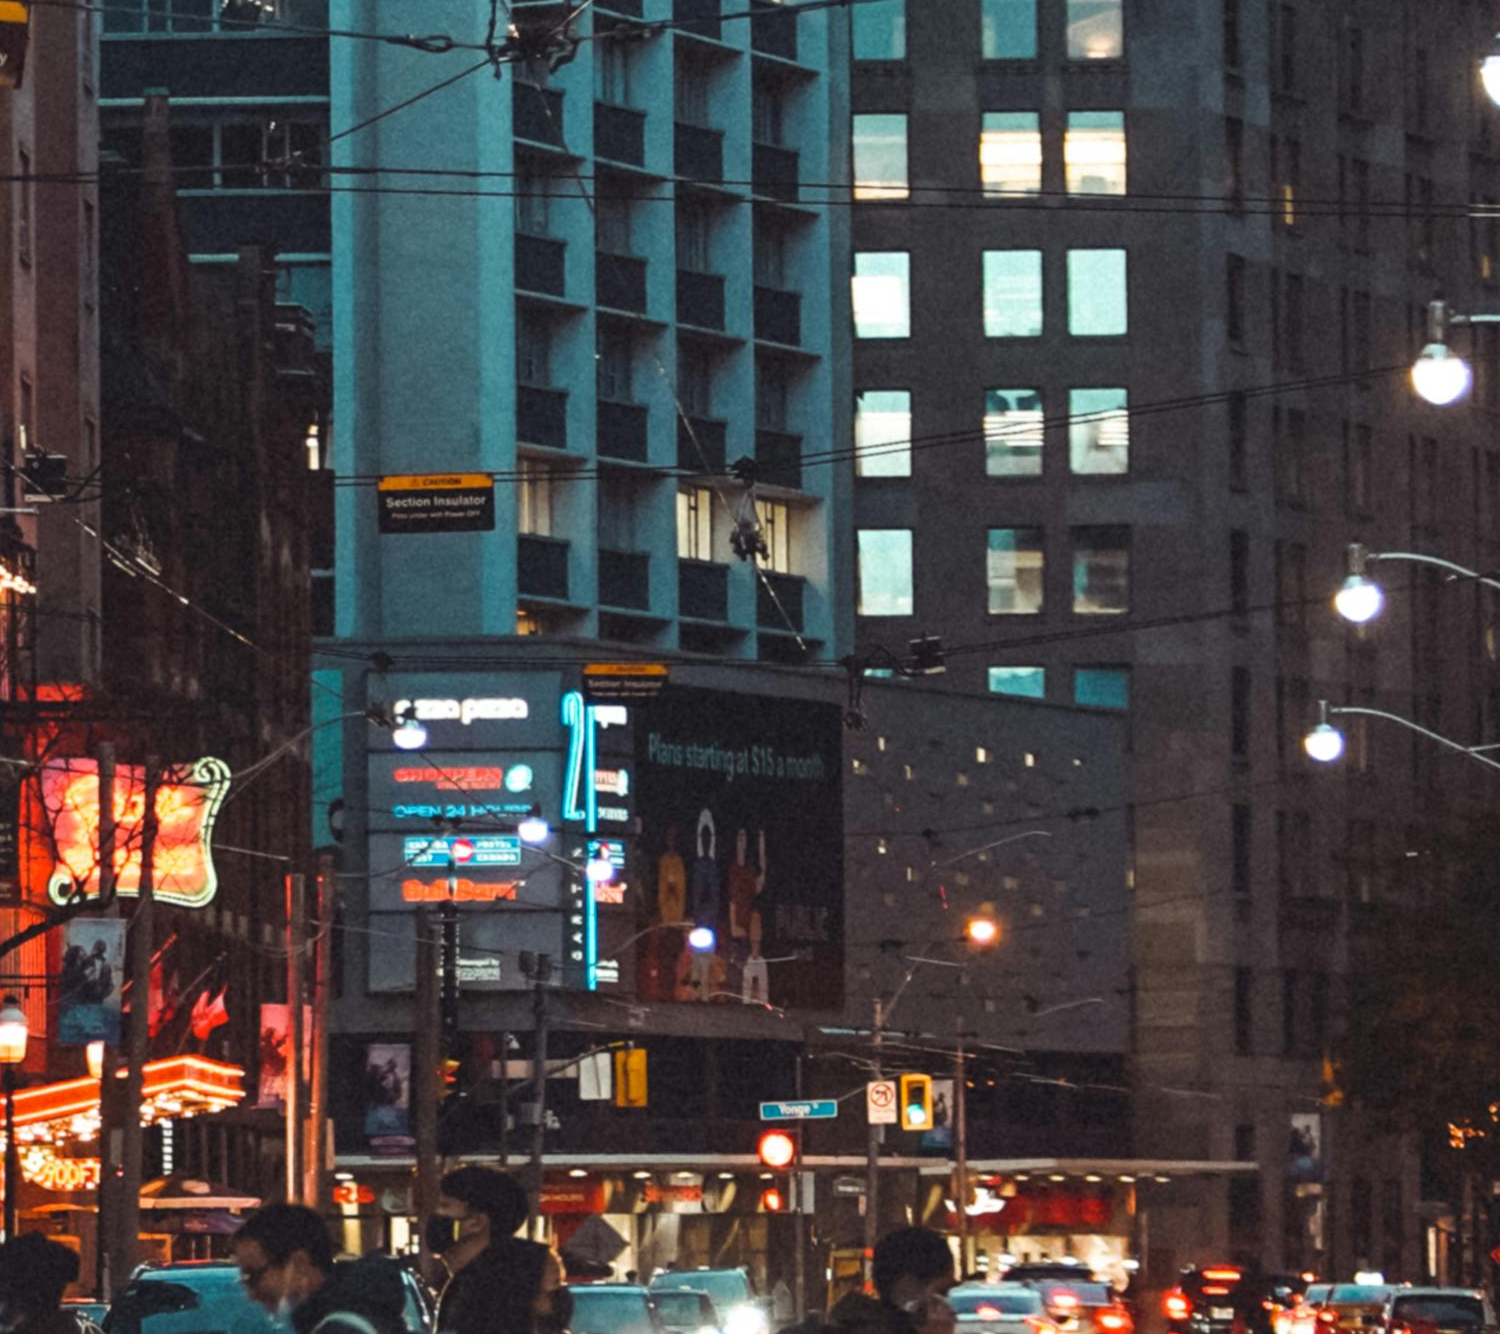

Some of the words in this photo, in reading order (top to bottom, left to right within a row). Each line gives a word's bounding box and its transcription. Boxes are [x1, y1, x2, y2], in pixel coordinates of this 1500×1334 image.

[386, 496, 431, 508] Section
[433, 494, 487, 507] Insulator
[648, 732, 683, 766] Plans
[686, 740, 734, 783] starting
[737, 747, 748, 774] at
[776, 755, 785, 778] a
[787, 754, 825, 780] month
[392, 804, 441, 818] OPEN
[445, 805, 466, 818] 24
[777, 1103, 812, 1117] Yonge
